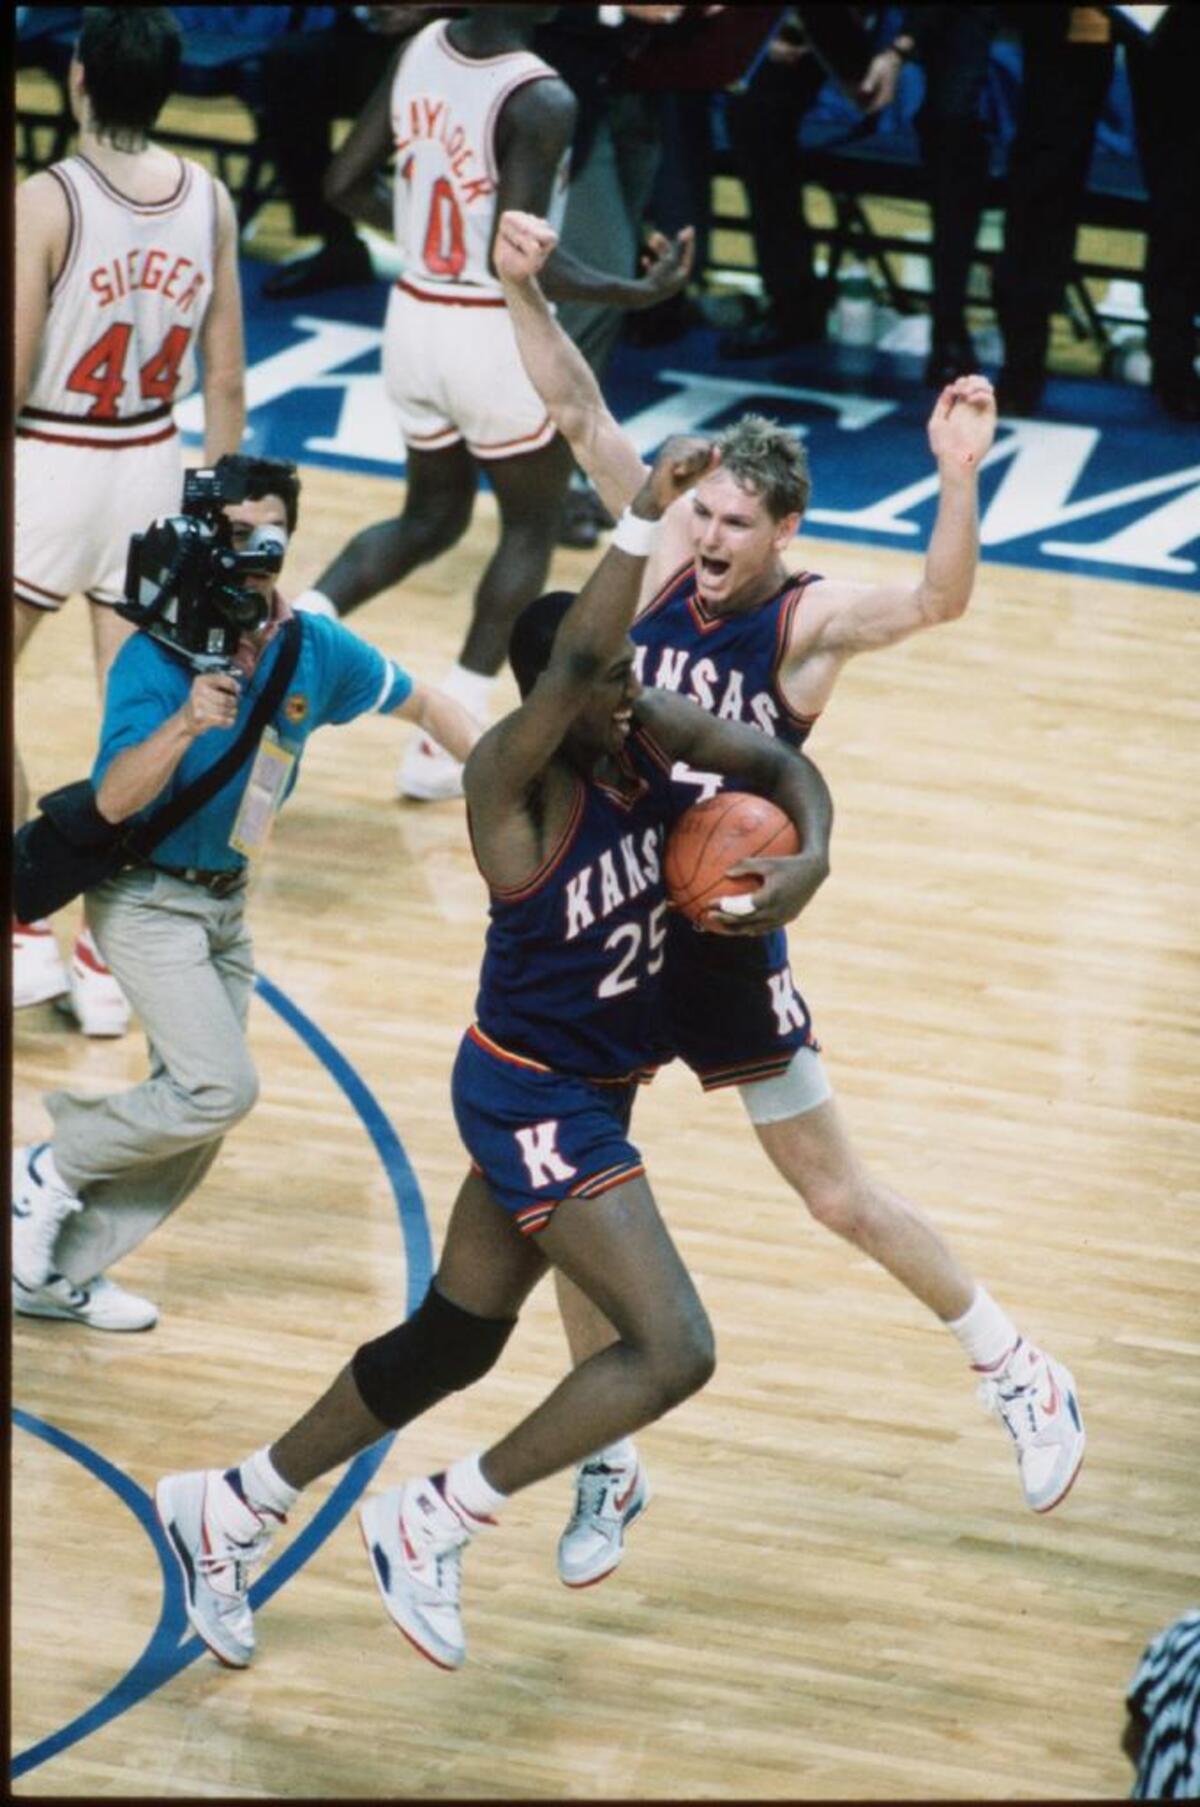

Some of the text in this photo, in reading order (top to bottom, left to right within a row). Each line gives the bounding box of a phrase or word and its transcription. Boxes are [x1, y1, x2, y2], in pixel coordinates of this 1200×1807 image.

[90, 249, 205, 313] SIEGER
[66, 321, 192, 421] 44
[565, 821, 664, 941] KANS
[597, 897, 668, 999] 25
[766, 966, 806, 1035] K
[514, 1120, 578, 1190] K
